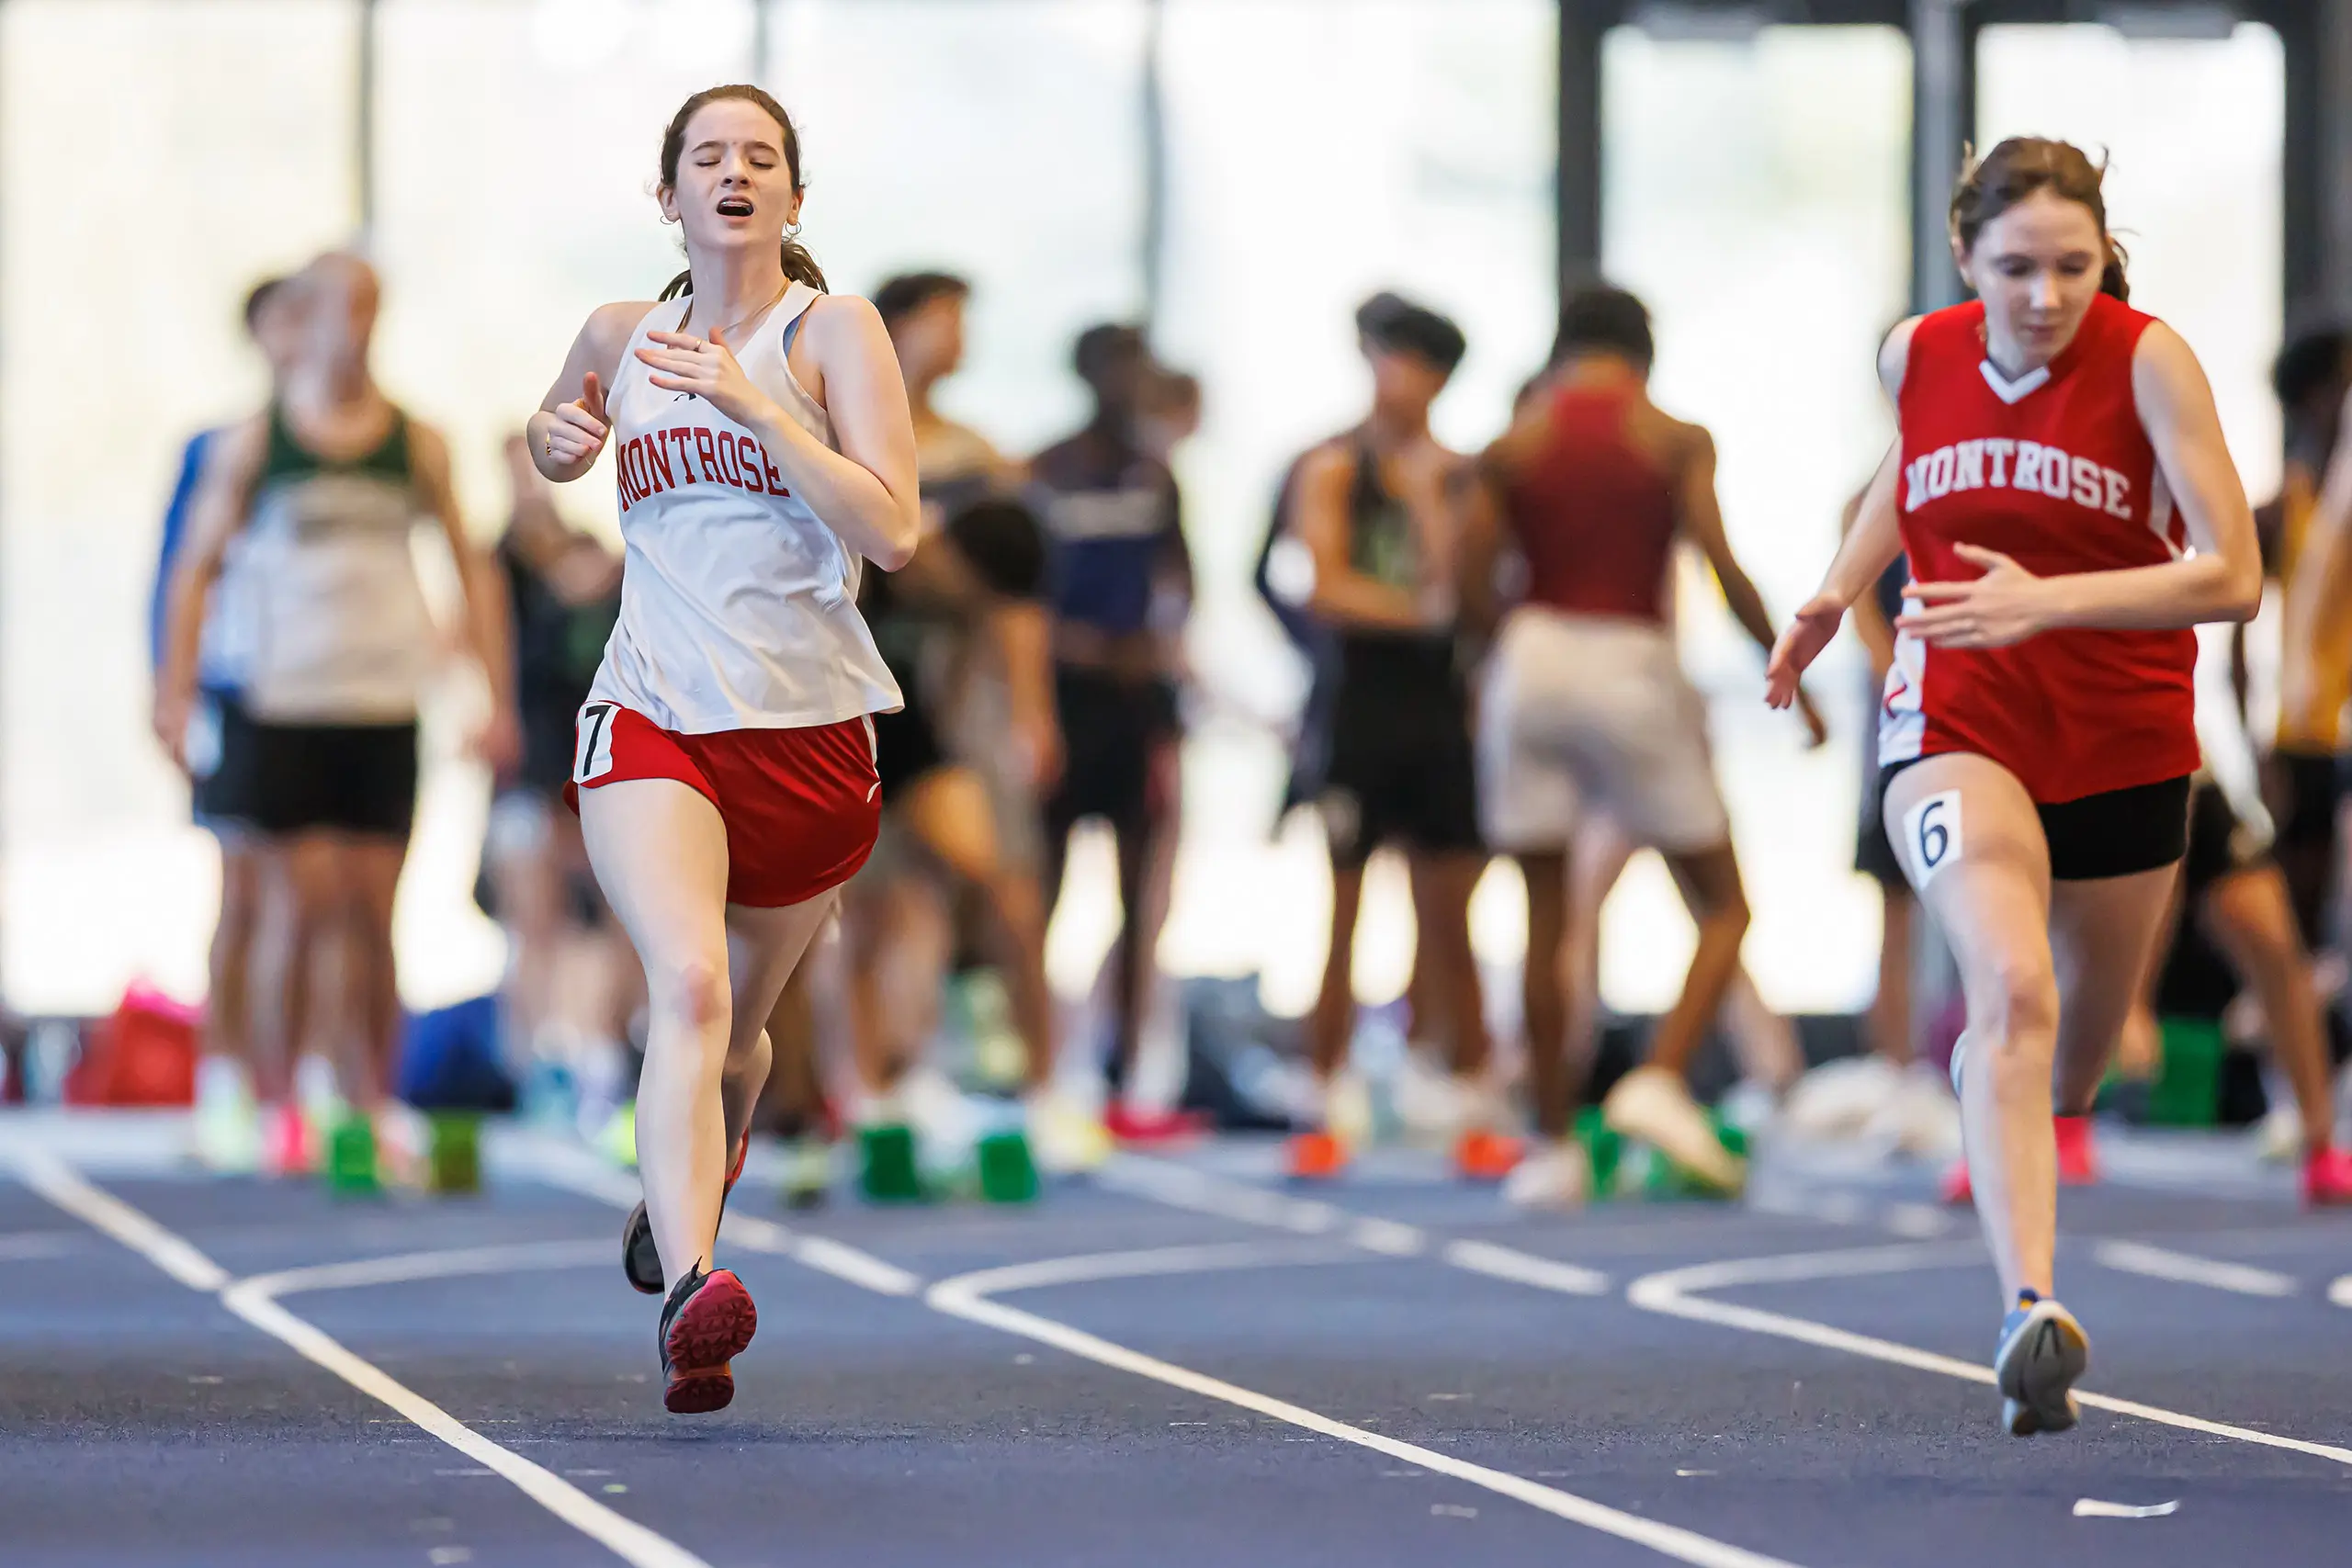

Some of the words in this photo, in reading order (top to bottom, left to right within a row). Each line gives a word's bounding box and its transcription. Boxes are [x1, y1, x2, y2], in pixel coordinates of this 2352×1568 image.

[617, 427, 790, 513] MONTROSE
[1905, 437, 2132, 521] MONTROSE
[582, 705, 612, 777] 7
[1919, 801, 1948, 868] 6
